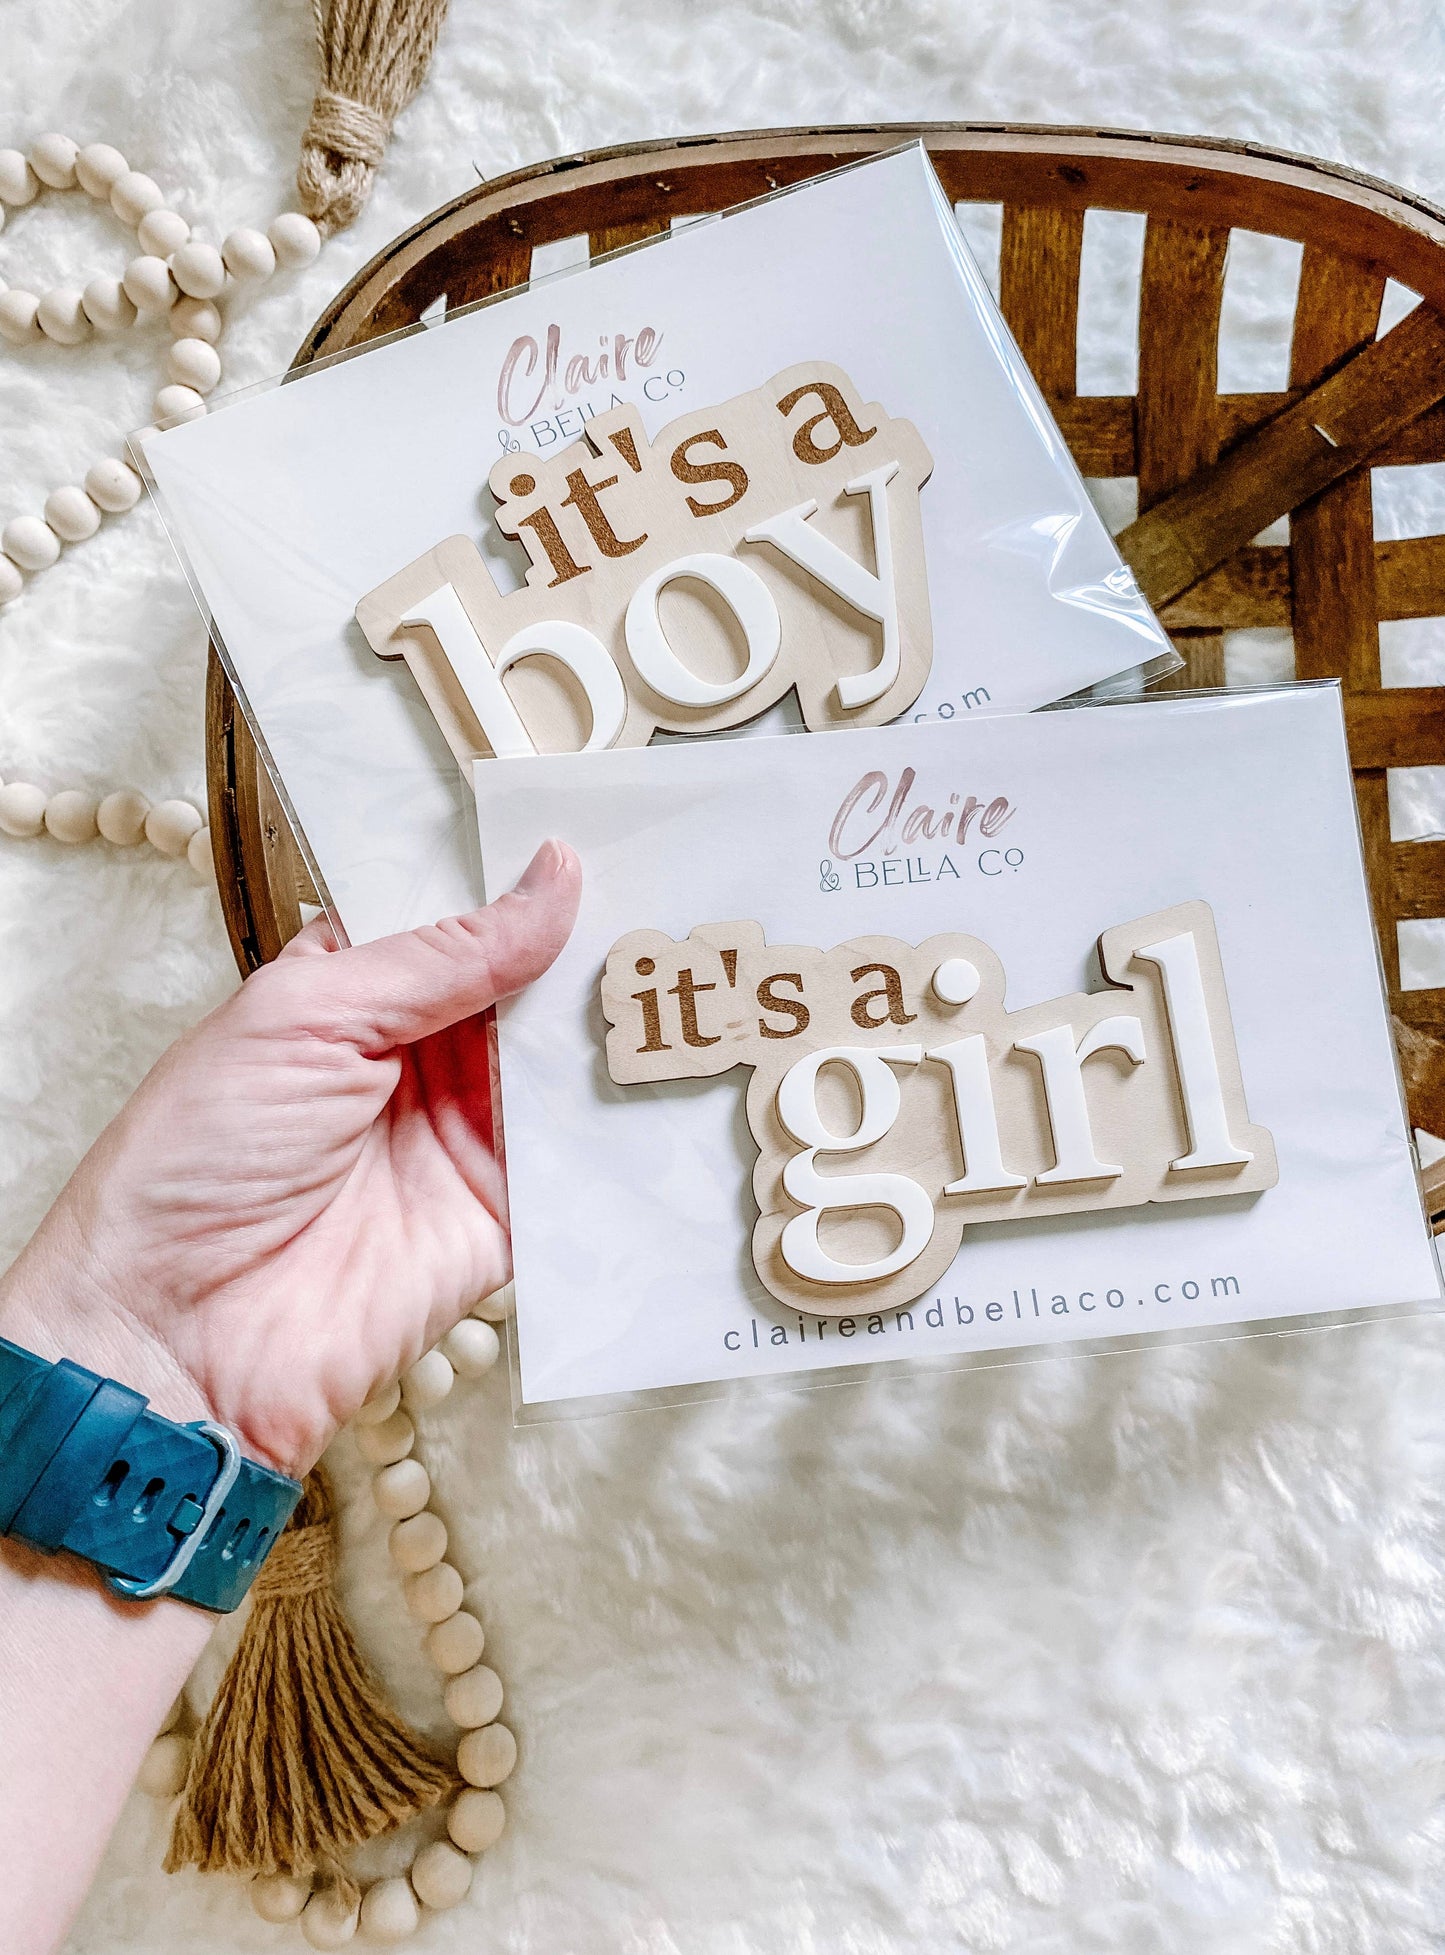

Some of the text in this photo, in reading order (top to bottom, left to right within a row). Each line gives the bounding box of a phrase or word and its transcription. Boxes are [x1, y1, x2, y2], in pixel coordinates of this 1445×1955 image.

[497, 323, 664, 426] Claire
[509, 382, 878, 589] it's a
[400, 460, 901, 758] boy
[828, 766, 1018, 861] Claire
[819, 859, 842, 893] &
[854, 854, 961, 888] BELLA
[630, 948, 918, 1053] it's a
[777, 931, 1254, 1284] girl
[723, 1273, 1242, 1351] claireandbellaco.com
